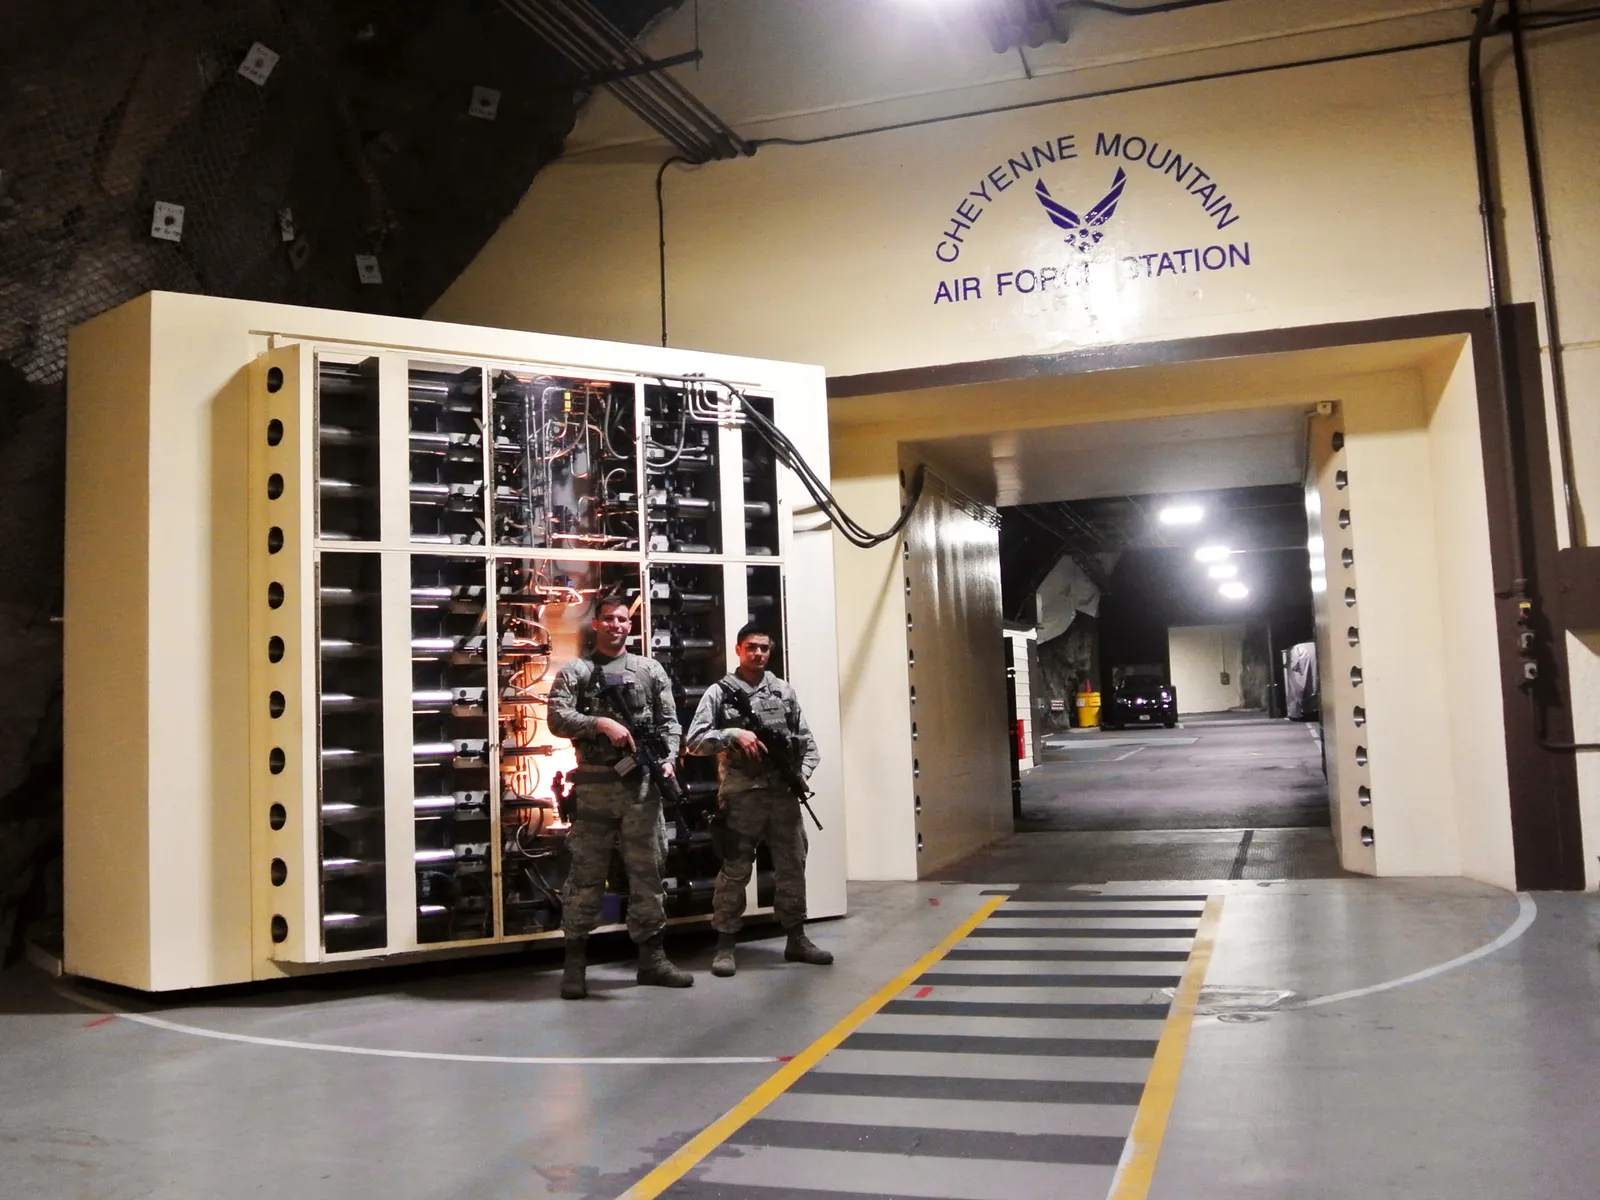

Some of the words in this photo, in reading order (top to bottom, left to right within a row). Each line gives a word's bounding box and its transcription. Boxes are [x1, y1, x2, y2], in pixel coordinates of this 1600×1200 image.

[936, 134, 1078, 263] CHEYENNE
[1095, 132, 1240, 230] MOUNTAIN
[934, 277, 982, 305] AIR
[996, 260, 1102, 296] FORC
